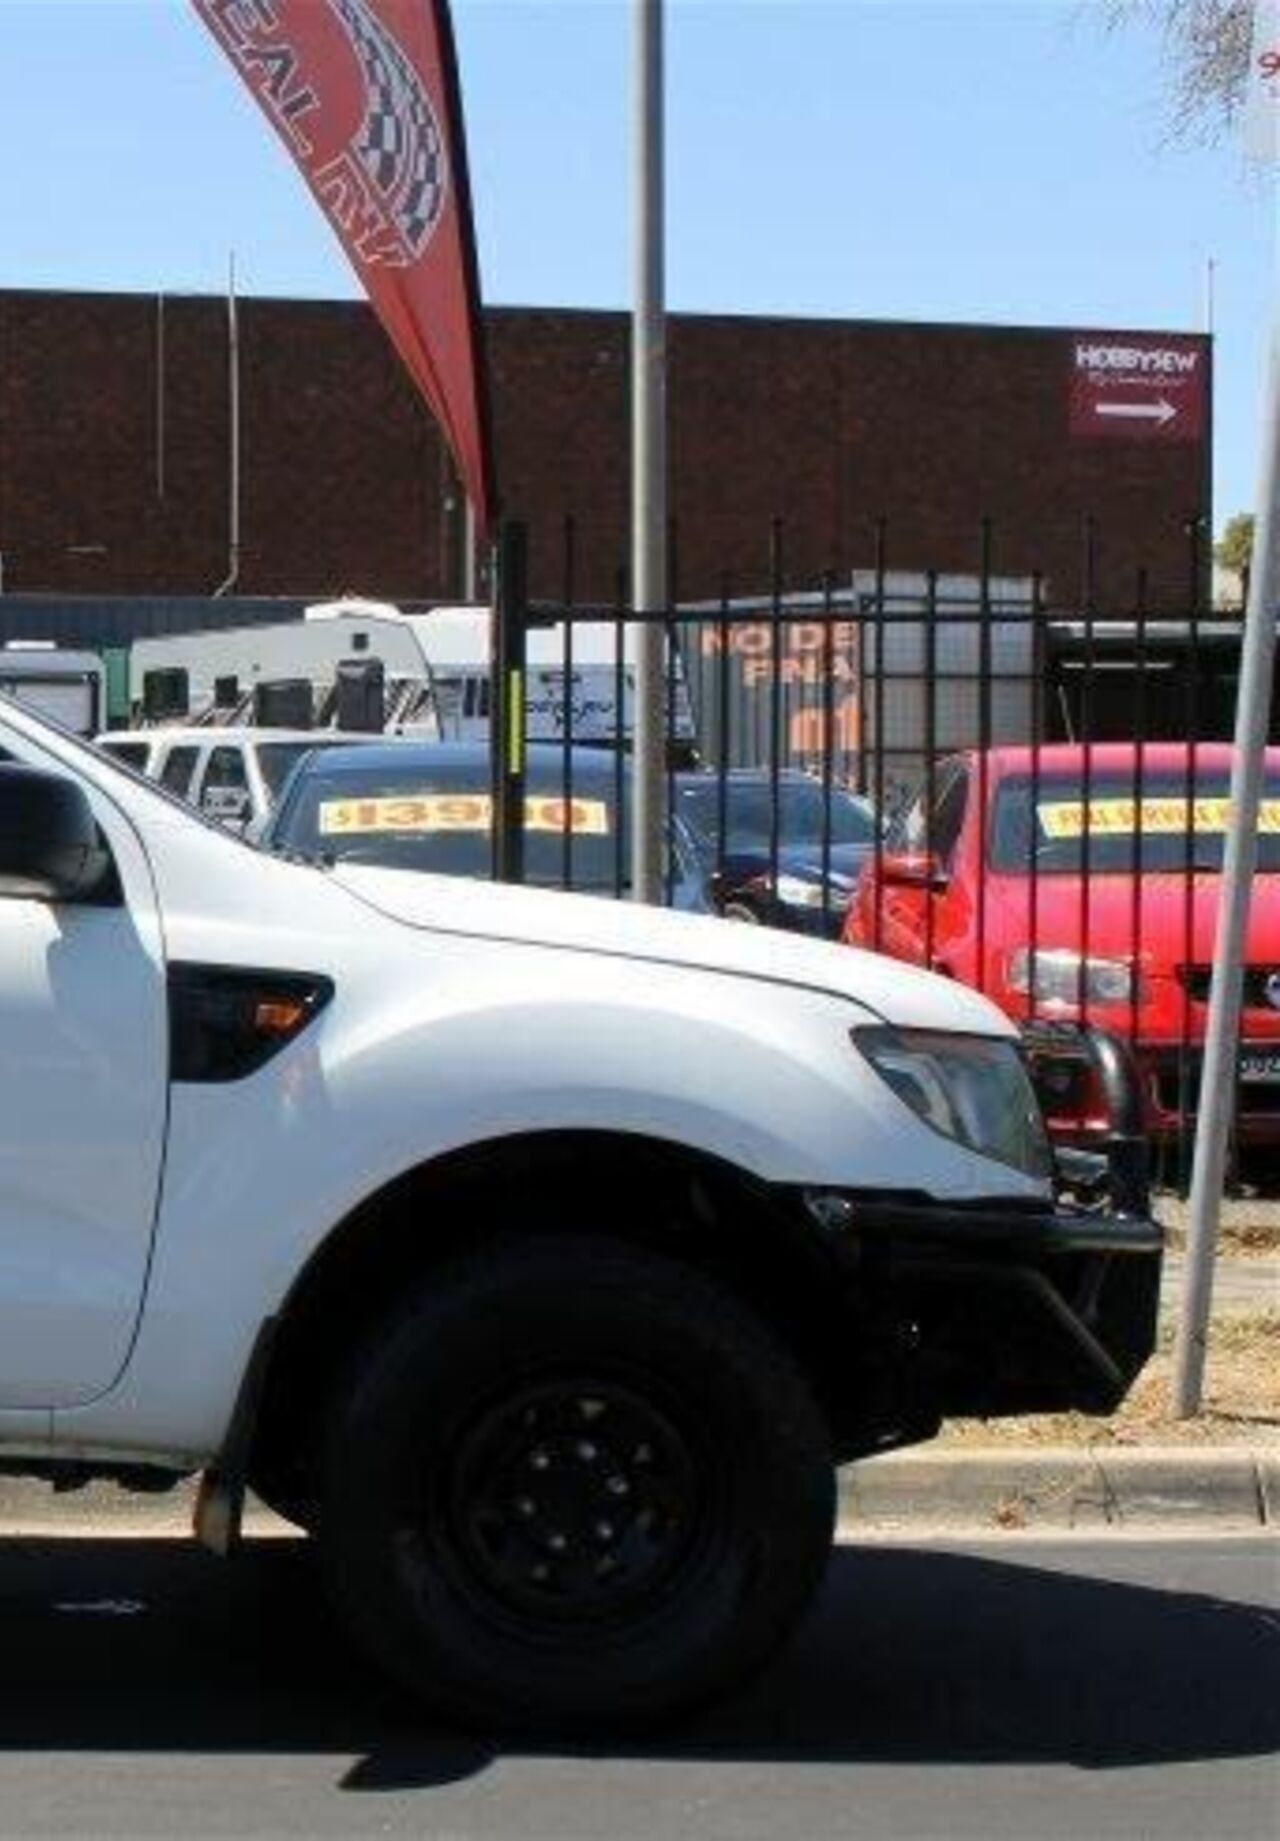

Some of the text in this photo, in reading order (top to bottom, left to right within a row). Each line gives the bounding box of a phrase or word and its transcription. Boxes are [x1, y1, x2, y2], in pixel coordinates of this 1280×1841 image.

[1076, 344, 1200, 372] HOBBYSEW
[701, 627, 773, 656] NO
[333, 799, 588, 828] $1390
